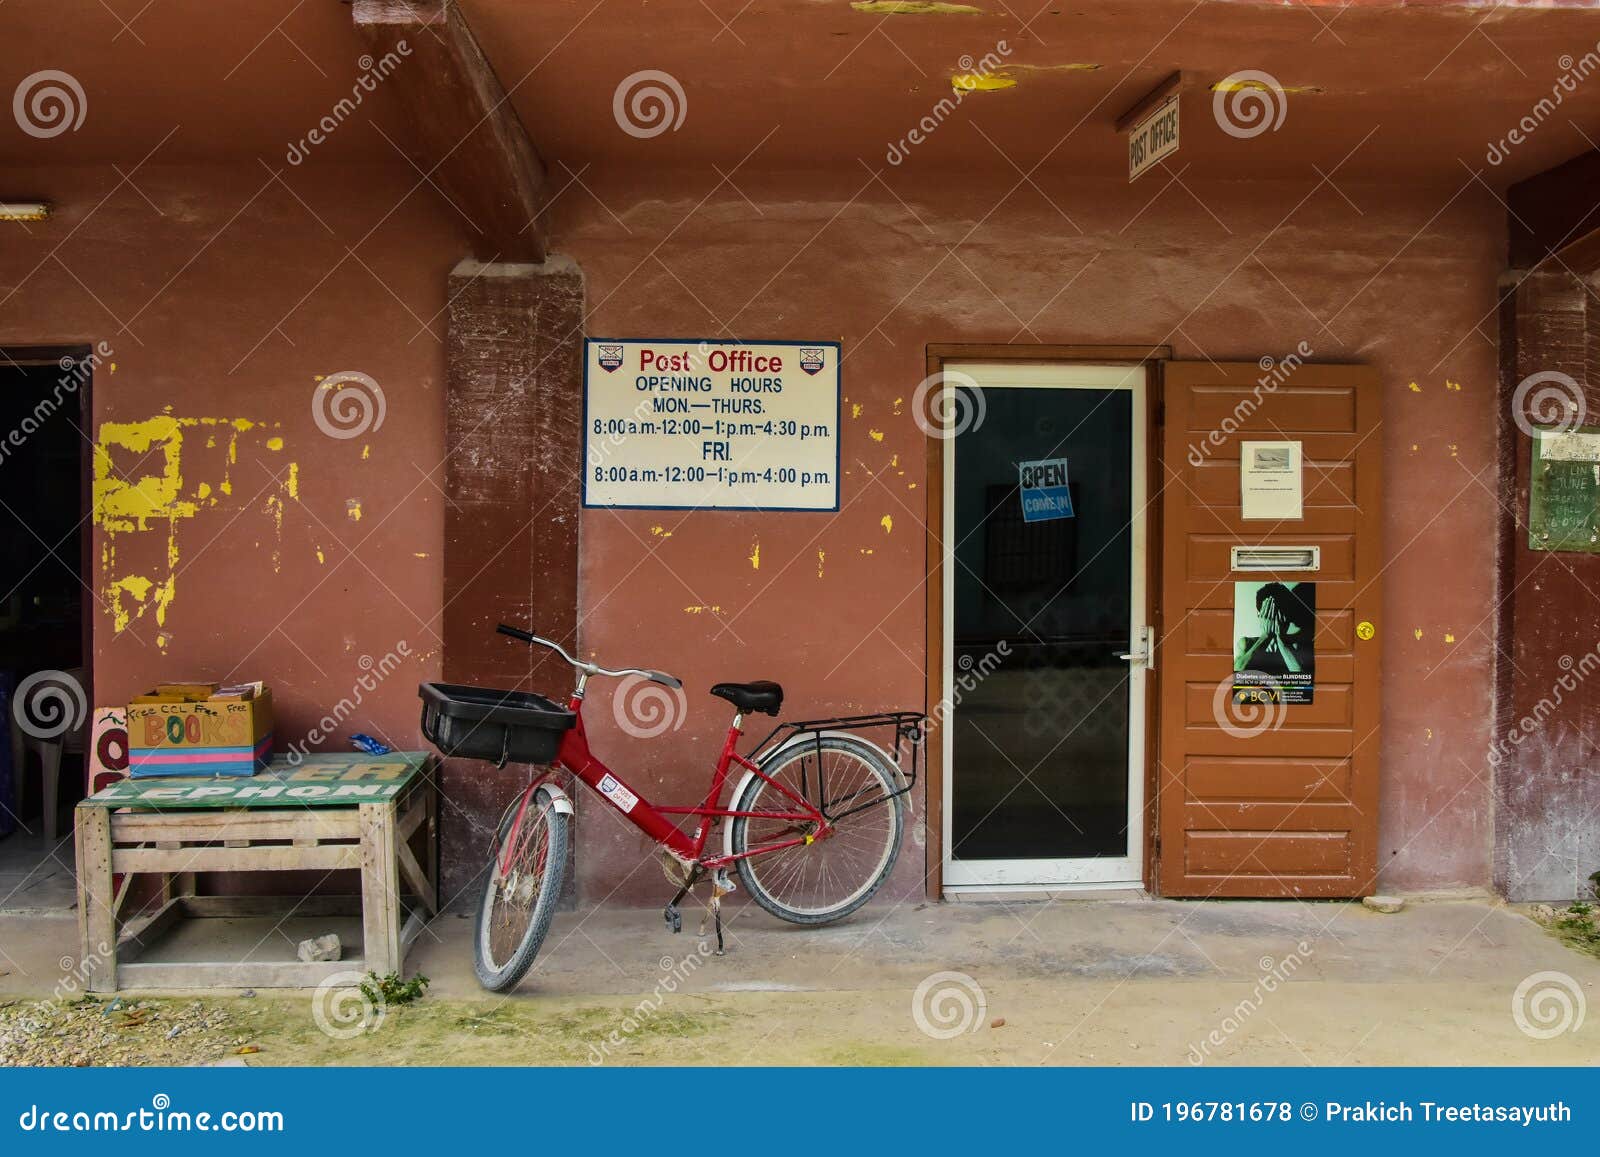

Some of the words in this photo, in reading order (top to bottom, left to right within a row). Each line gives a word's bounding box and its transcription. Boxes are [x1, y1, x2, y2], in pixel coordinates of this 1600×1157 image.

[1130, 131, 1148, 171] POST
[1150, 109, 1176, 154] OFFICE
[640, 349, 690, 372] Post
[708, 350, 783, 373] Office
[635, 376, 712, 392] OPENING
[730, 377, 782, 393] HOURS
[702, 442, 733, 461] FRI.
[1022, 464, 1066, 489] OPEN
[1025, 497, 1056, 512] COME
[1057, 495, 1069, 509] IN
[1250, 690, 1280, 702] BCVI
[144, 713, 248, 747] BOOKS
